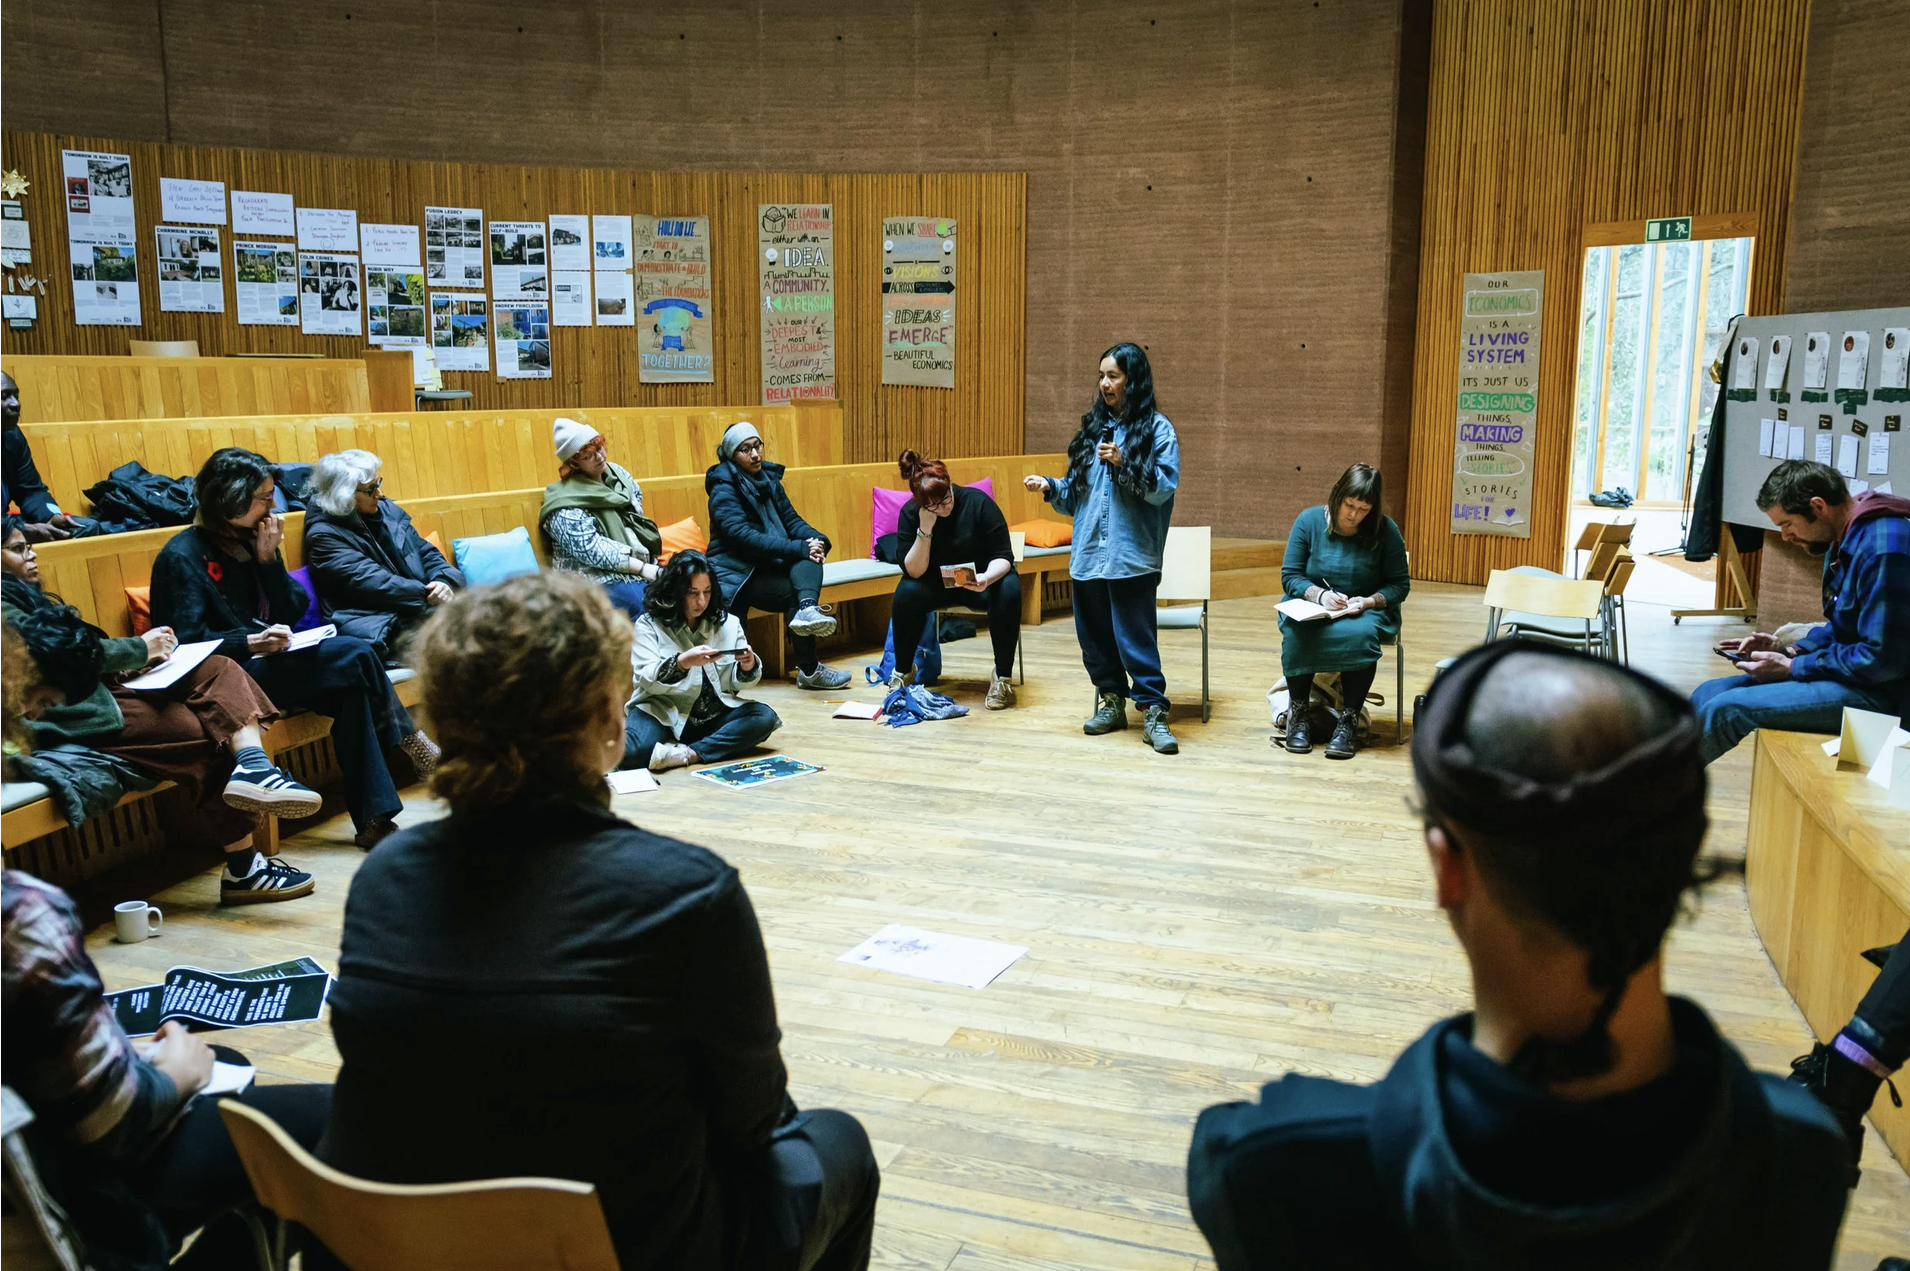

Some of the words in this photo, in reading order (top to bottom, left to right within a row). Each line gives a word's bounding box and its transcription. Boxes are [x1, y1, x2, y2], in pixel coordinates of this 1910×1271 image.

[799, 207, 820, 219] LEARN
[822, 208, 830, 219] IN
[885, 223, 904, 236] WHEN
[907, 223, 915, 235] WE
[918, 223, 936, 236] SHARE
[687, 263, 706, 275] BUILD
[893, 265, 939, 279] VISIONS
[764, 281, 771, 290] A
[890, 282, 914, 294] ACROSS
[1488, 280, 1509, 288] OUR
[784, 296, 793, 311] A
[1468, 295, 1532, 312] ECONOMICS
[895, 309, 941, 324] IDEAS
[1502, 320, 1509, 328] A
[771, 325, 817, 338] DEEPEST
[1469, 331, 1530, 346] LIVING
[774, 342, 824, 354] EMBODIED
[641, 354, 711, 369] TOGETHER?
[1467, 349, 1525, 364] SYSTEM
[913, 361, 953, 370] ECONOMICS
[770, 375, 801, 386] COMES
[804, 373, 825, 382] FROM
[1484, 377, 1508, 386] JUST
[1515, 377, 1529, 387] US
[1461, 394, 1534, 411] DESIGNING
[1462, 425, 1522, 442] MAKING
[1465, 485, 1518, 500] STORIES
[1454, 503, 1490, 521] LIFE!
